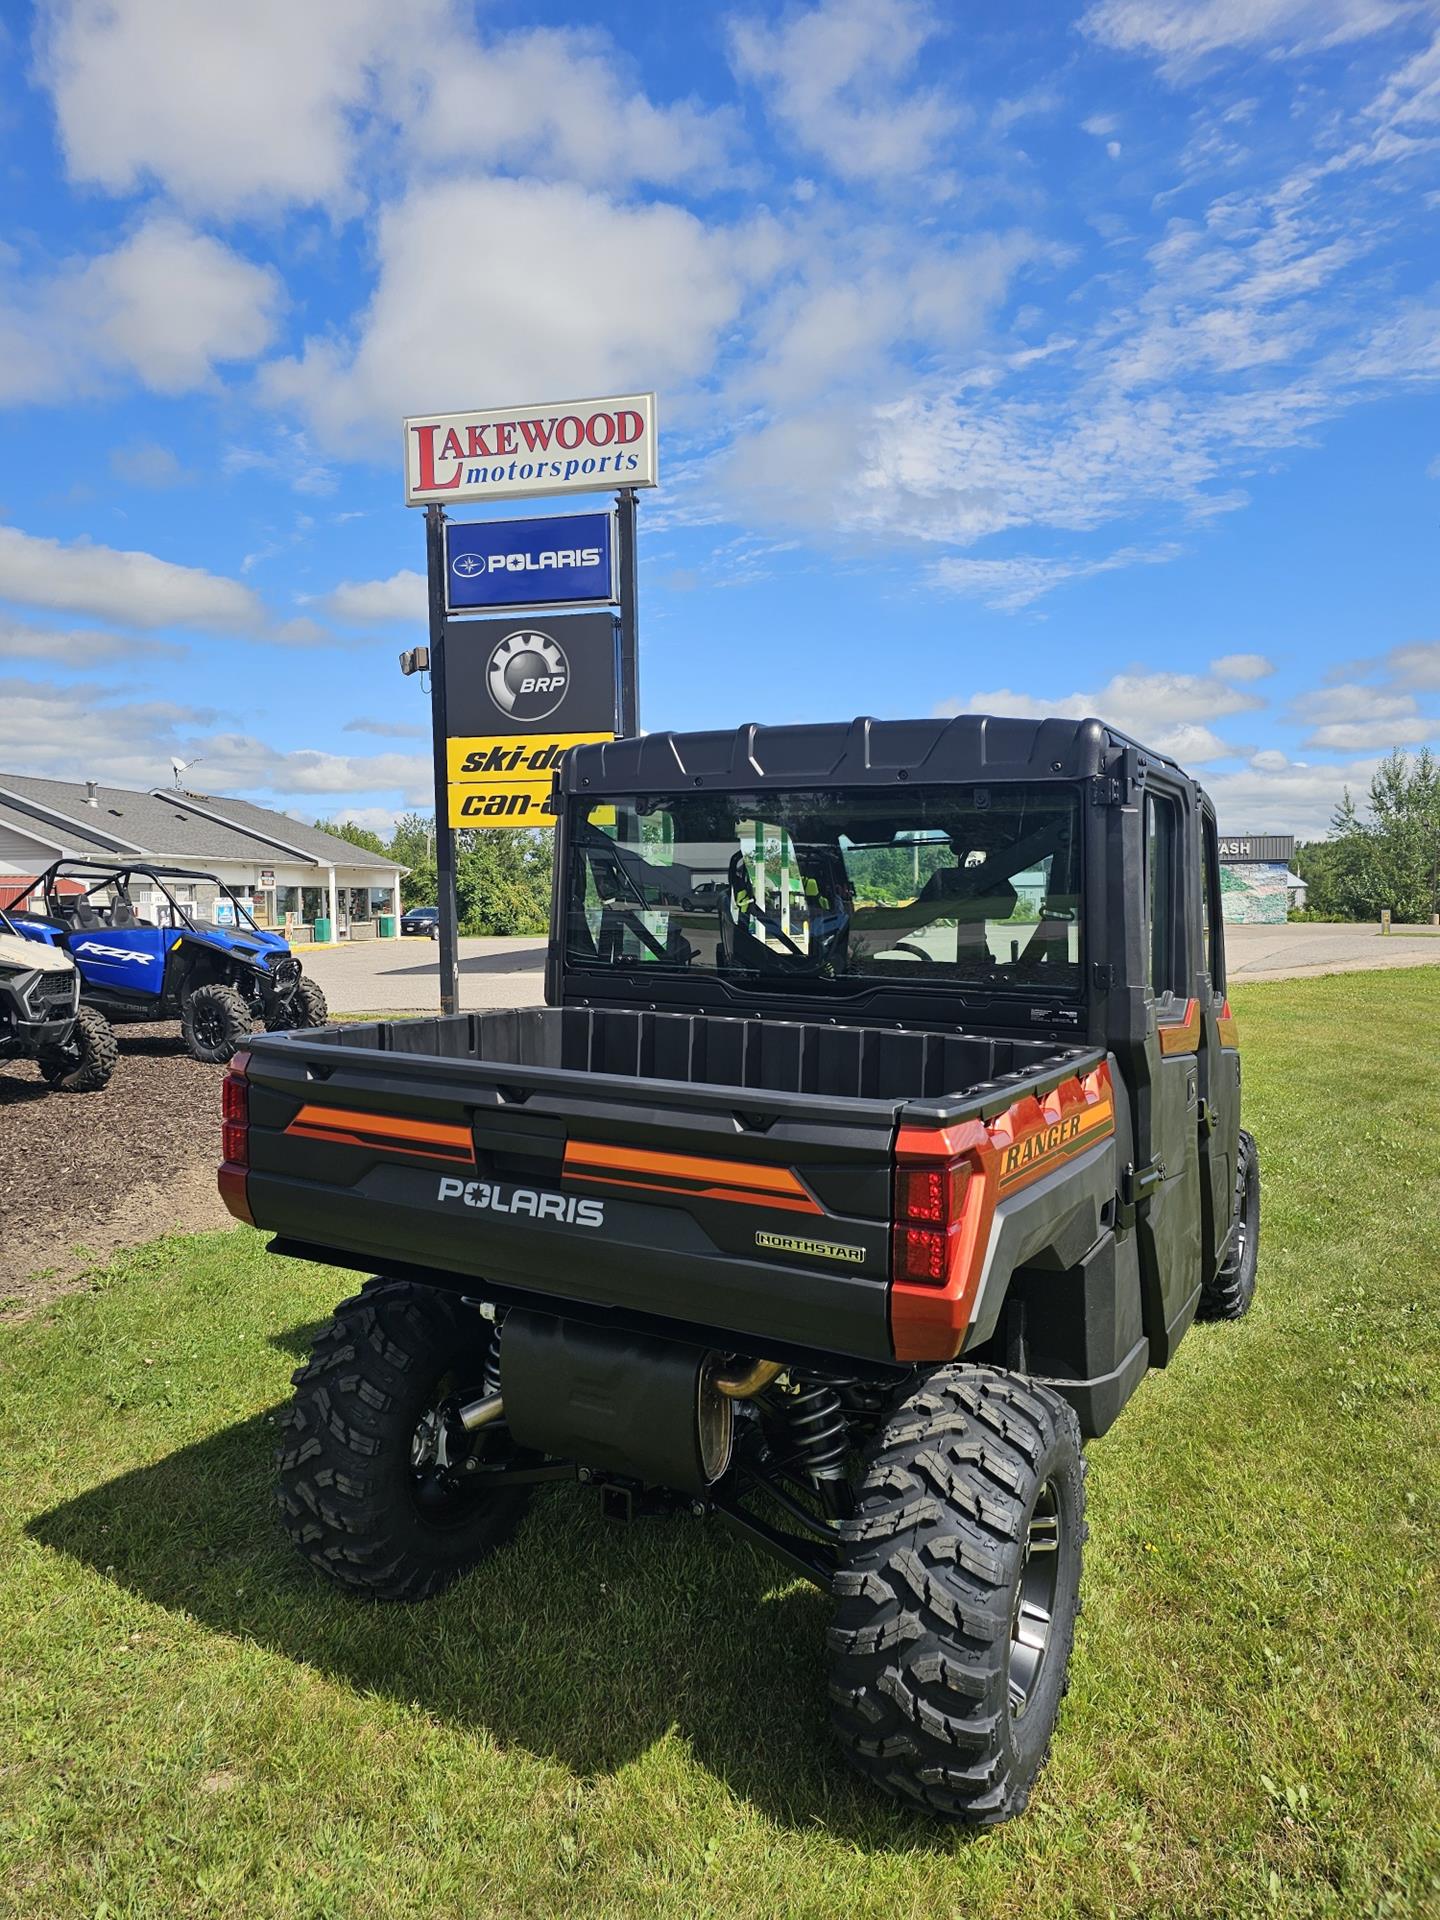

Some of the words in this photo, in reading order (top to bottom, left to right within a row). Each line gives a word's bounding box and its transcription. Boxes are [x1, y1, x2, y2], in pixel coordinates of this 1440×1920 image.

[410, 410, 645, 492] LAKEWOOD
[466, 450, 640, 484] motorsports
[488, 548, 600, 573] POLARIS
[520, 676, 566, 694] BRP
[1218, 842, 1250, 855] ASH
[76, 941, 156, 966] RZR
[1005, 1113, 1081, 1174] RANGER
[437, 1177, 604, 1227] POLARIS
[760, 1234, 860, 1260] NORTHSTAR
